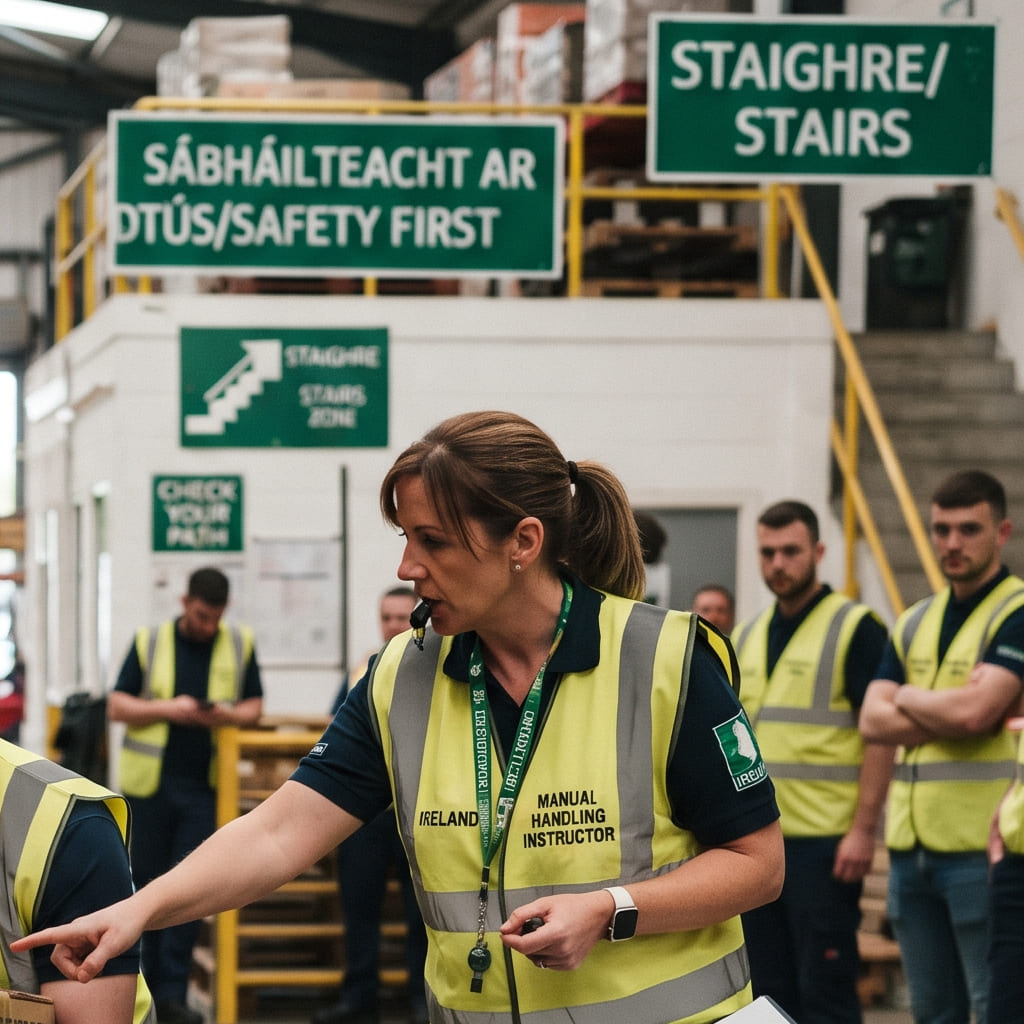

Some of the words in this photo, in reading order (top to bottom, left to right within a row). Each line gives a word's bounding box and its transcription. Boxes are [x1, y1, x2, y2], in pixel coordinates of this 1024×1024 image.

[671, 40, 949, 99] STAIGHRE/
[735, 107, 912, 157] STAIRS
[143, 133, 473, 189] SÁBHÁILTEACHT
[479, 148, 537, 190] AR
[391, 206, 501, 249] FIRST
[298, 384, 367, 407] STAIRS
[157, 479, 238, 502] CHECK
[163, 503, 232, 524] YOUR
[166, 525, 229, 548] PATH
[538, 790, 597, 809] MANUAL
[419, 811, 479, 827] IRELAND
[532, 808, 606, 828] HANDLING
[523, 827, 615, 848] INSTRUCTOR
